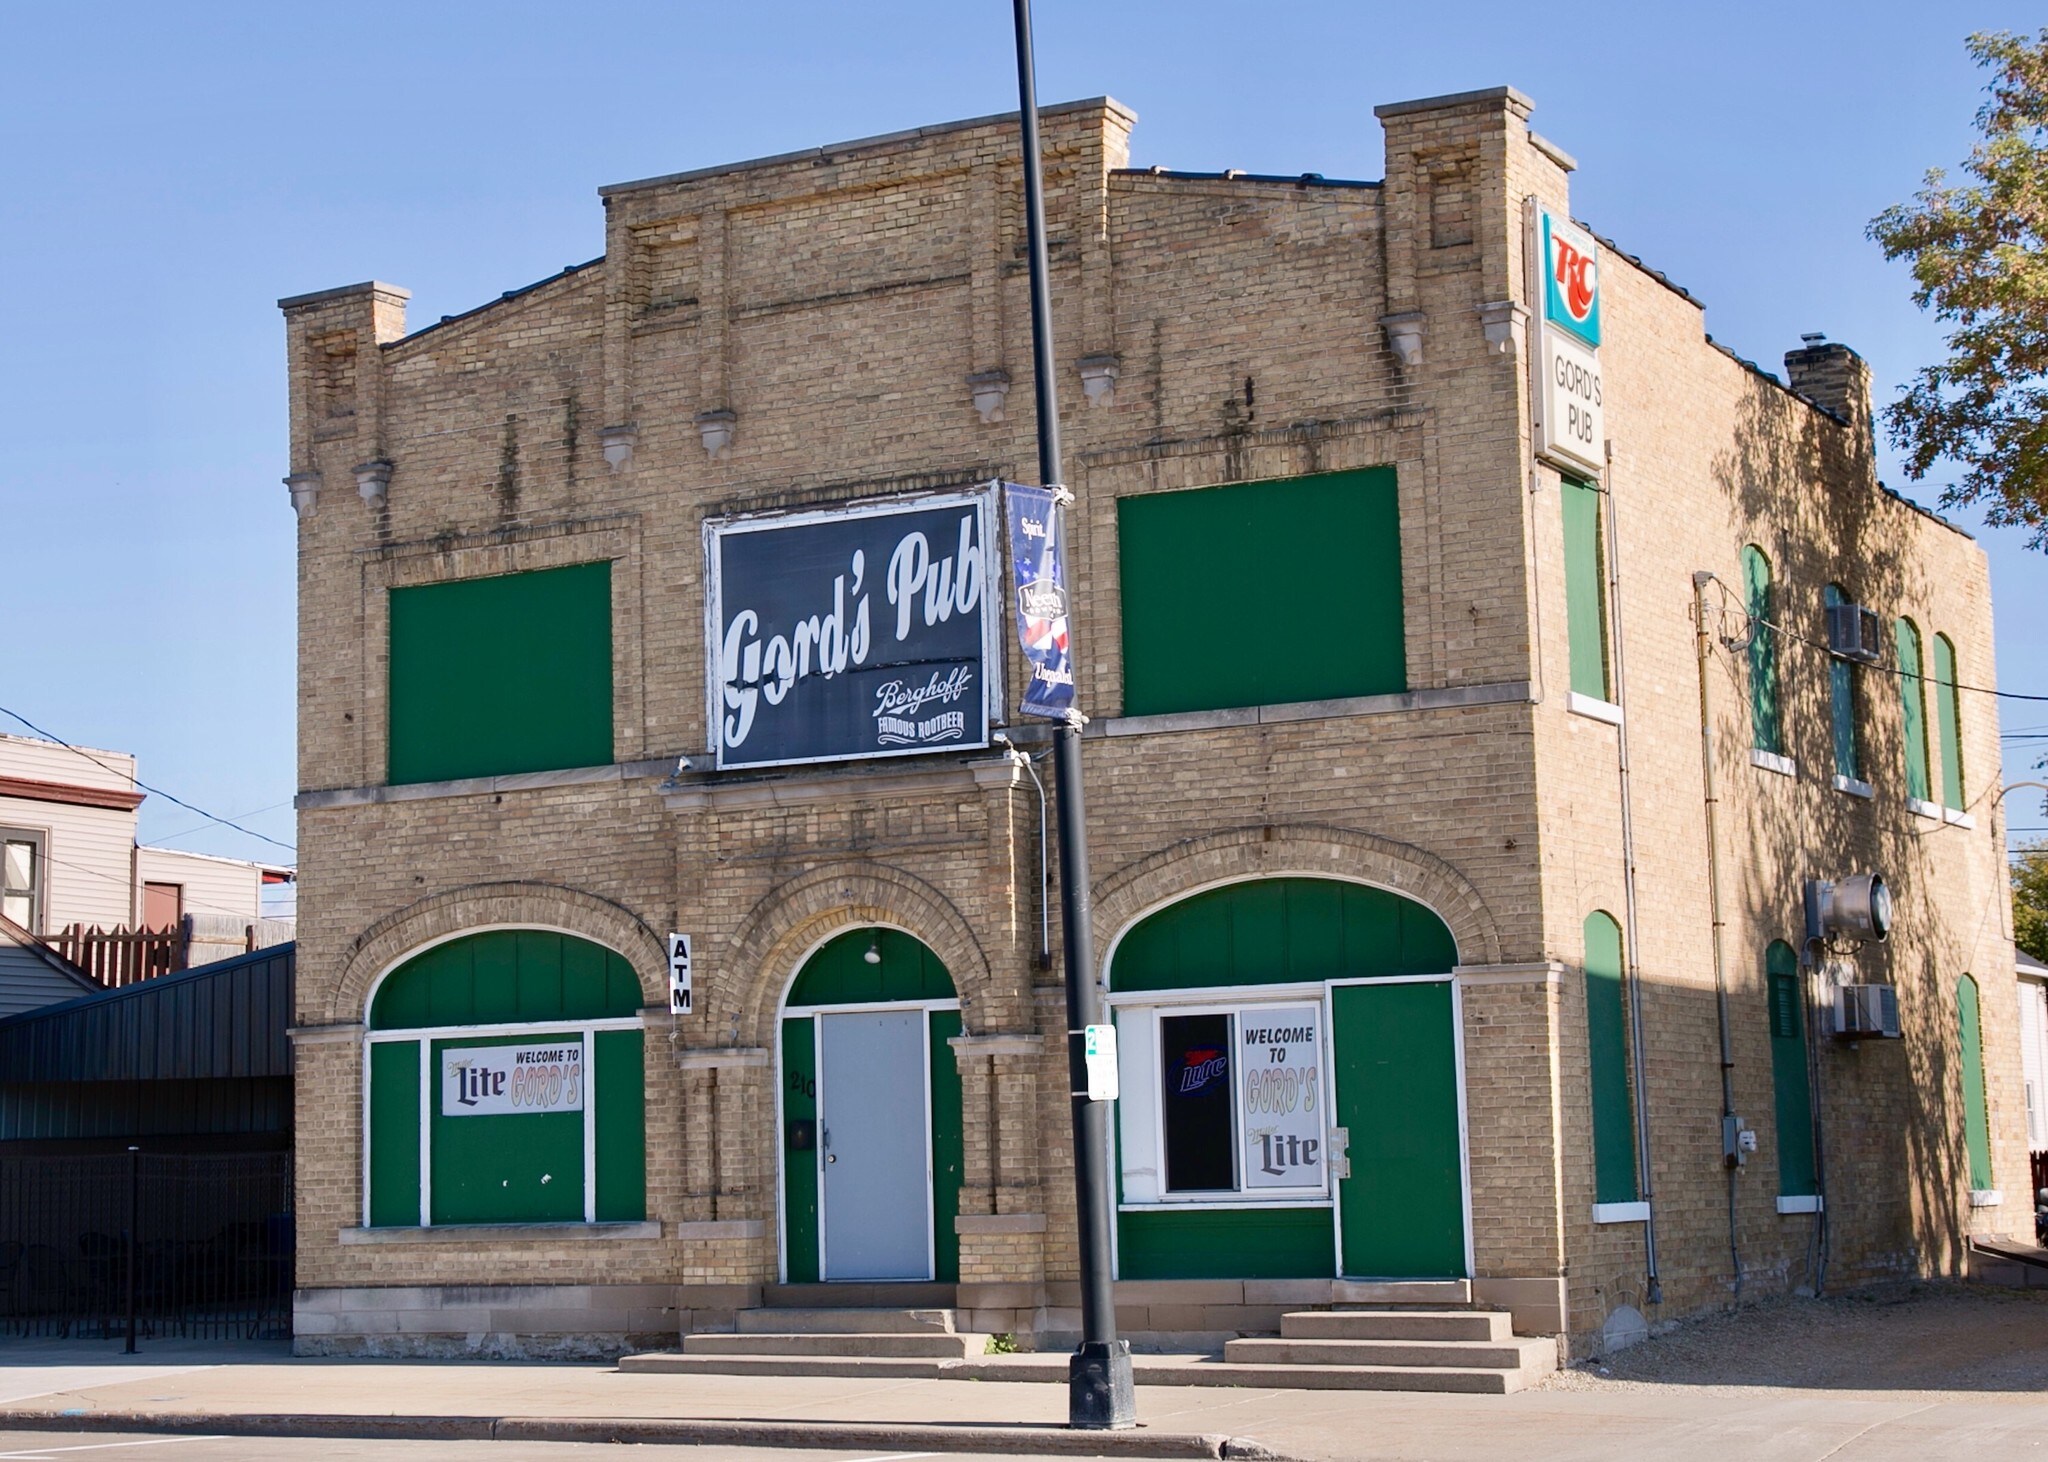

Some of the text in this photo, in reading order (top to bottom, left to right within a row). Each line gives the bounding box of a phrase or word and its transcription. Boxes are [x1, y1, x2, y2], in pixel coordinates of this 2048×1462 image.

[1551, 233, 1595, 320] RC
[1555, 354, 1602, 408] GORD'S
[1568, 403, 1593, 444] PUB
[723, 515, 981, 748] Gord's Pub
[872, 665, 973, 717] Berghoff
[878, 711, 965, 739] FAMOUS ROOTBEER
[673, 940, 691, 1008] ATM
[516, 1049, 579, 1064] WELCOME TO
[1245, 1026, 1313, 1045] WELCOME
[1269, 1047, 1286, 1063] TO
[457, 1066, 506, 1107] Lite
[511, 1064, 580, 1108] GORD'S
[790, 1070, 816, 1098] 210
[1246, 1066, 1317, 1117] GORD'S
[1261, 1134, 1319, 1176] Lite
